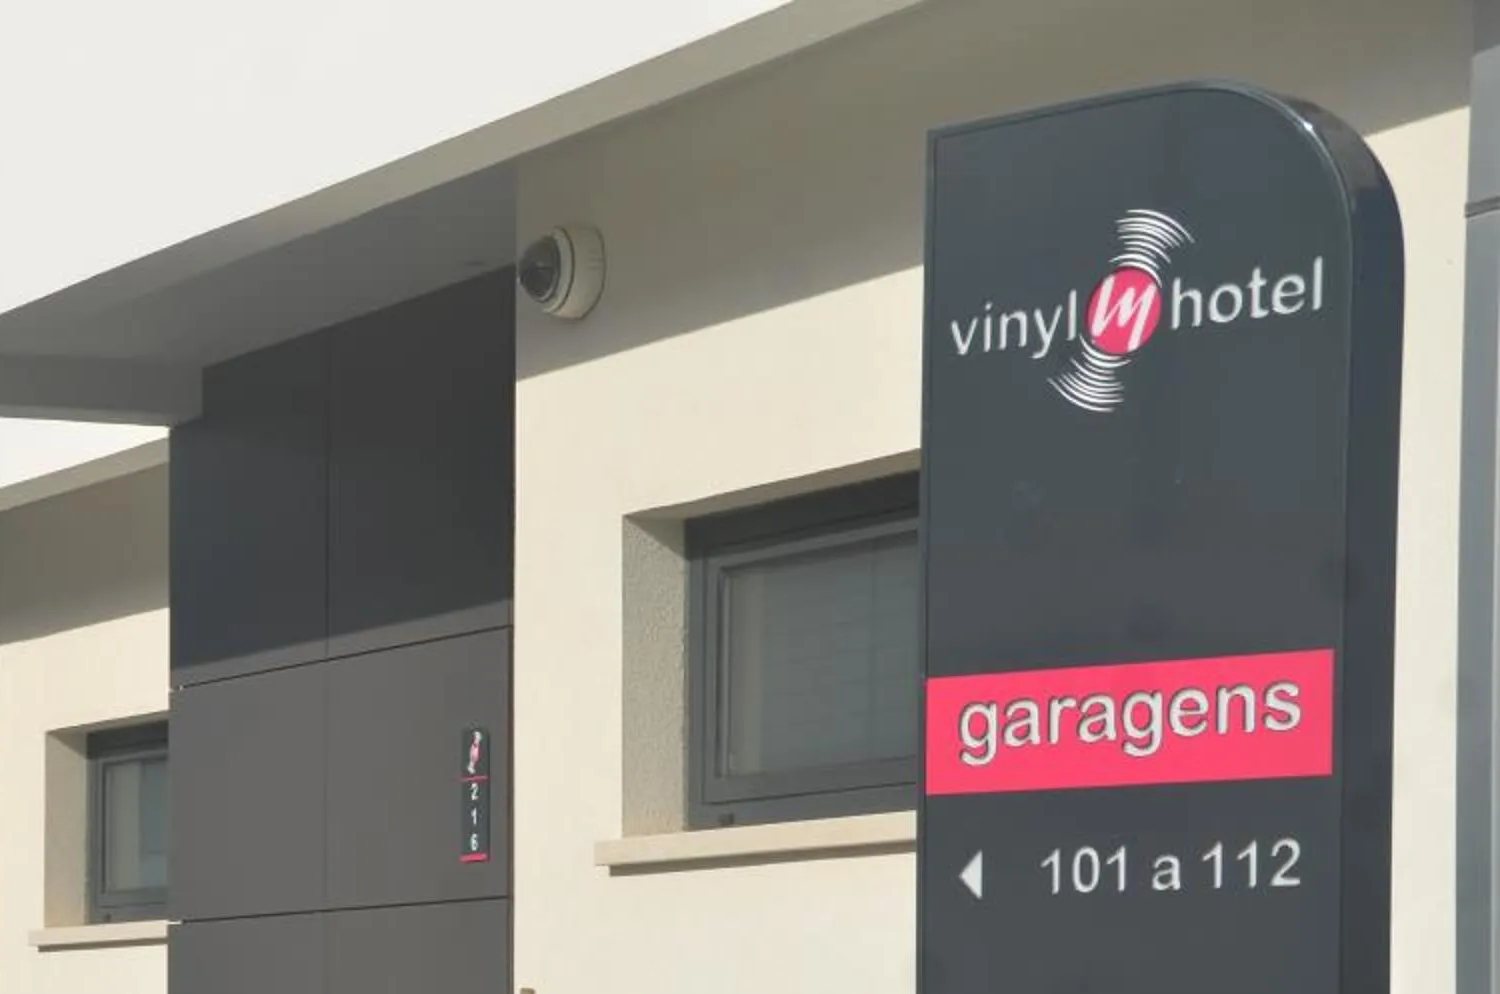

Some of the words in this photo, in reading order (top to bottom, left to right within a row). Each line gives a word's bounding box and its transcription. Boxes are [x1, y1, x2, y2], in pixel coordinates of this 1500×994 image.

[951, 289, 1078, 360] vinyl
[1170, 255, 1324, 331] hotel
[958, 680, 1302, 767] garagens
[1039, 845, 1128, 895] 101
[1150, 853, 1182, 892] a
[1201, 837, 1302, 890] 112
